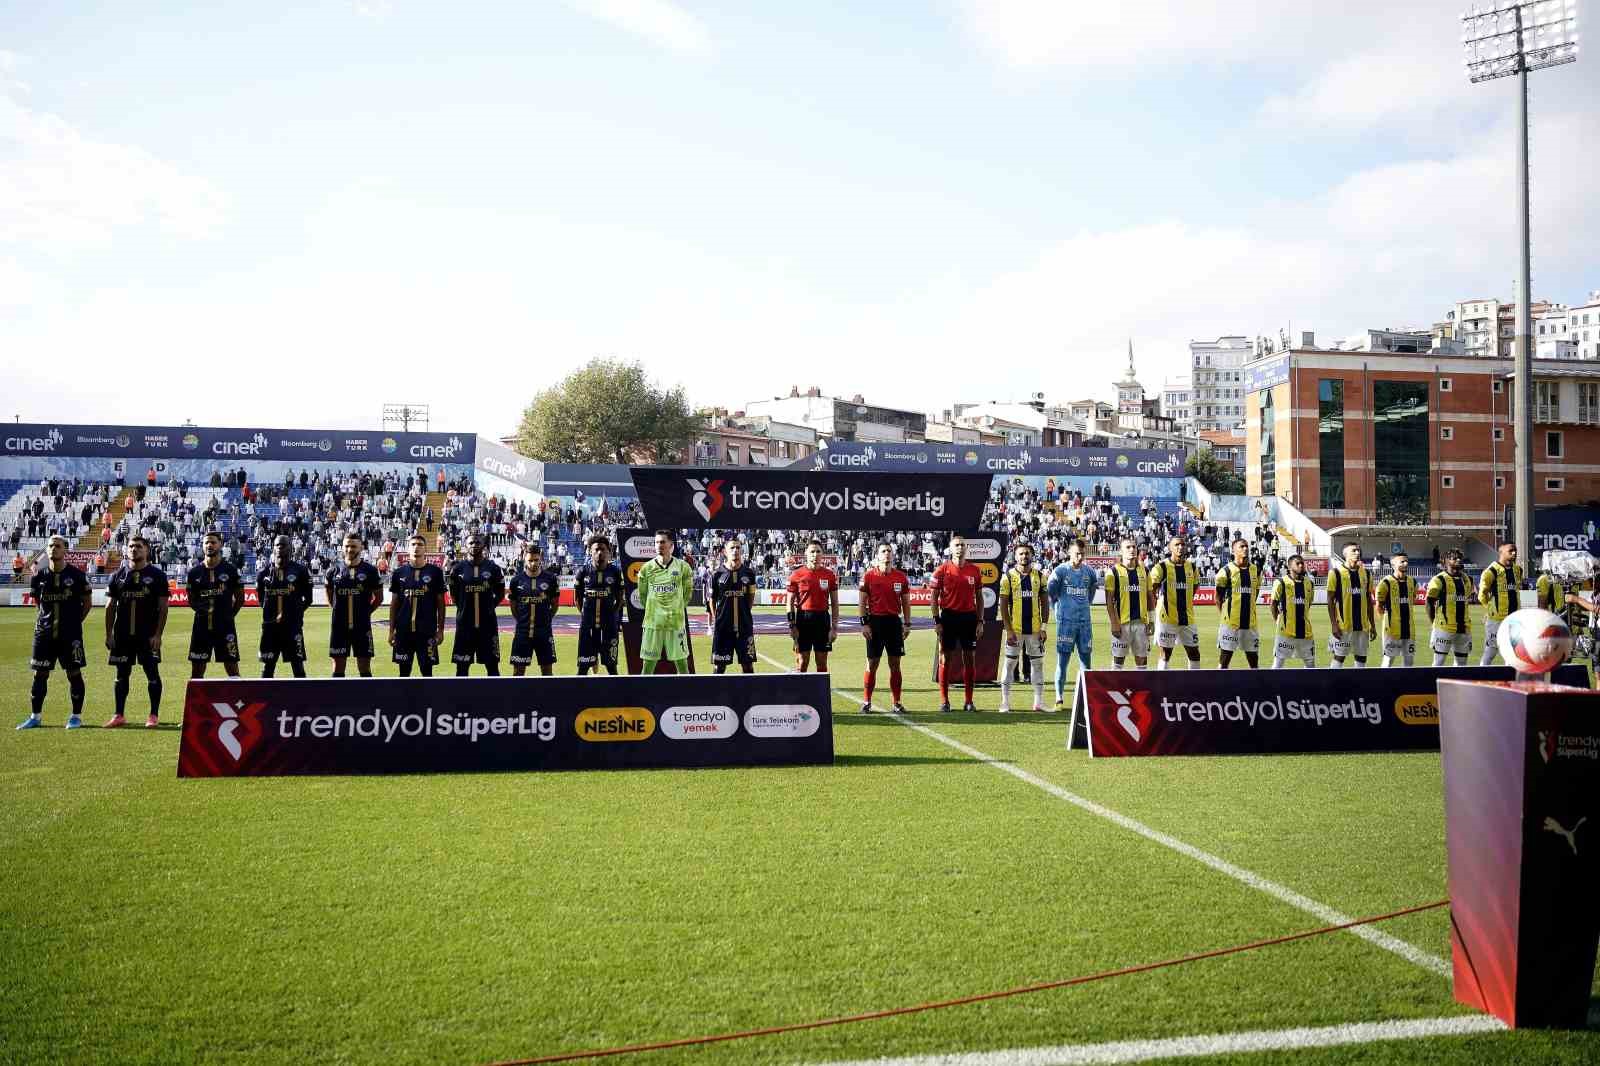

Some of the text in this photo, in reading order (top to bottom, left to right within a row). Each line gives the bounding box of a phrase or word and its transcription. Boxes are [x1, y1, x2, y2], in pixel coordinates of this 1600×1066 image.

[114, 462, 123, 471] E
[156, 463, 166, 472] D
[729, 485, 849, 515] trendyol
[1255, 499, 1263, 509] A
[1160, 695, 1285, 726] trendyol
[673, 711, 726, 723] trendyol
[276, 707, 433, 743] trendyol
[683, 723, 719, 734] yemek
